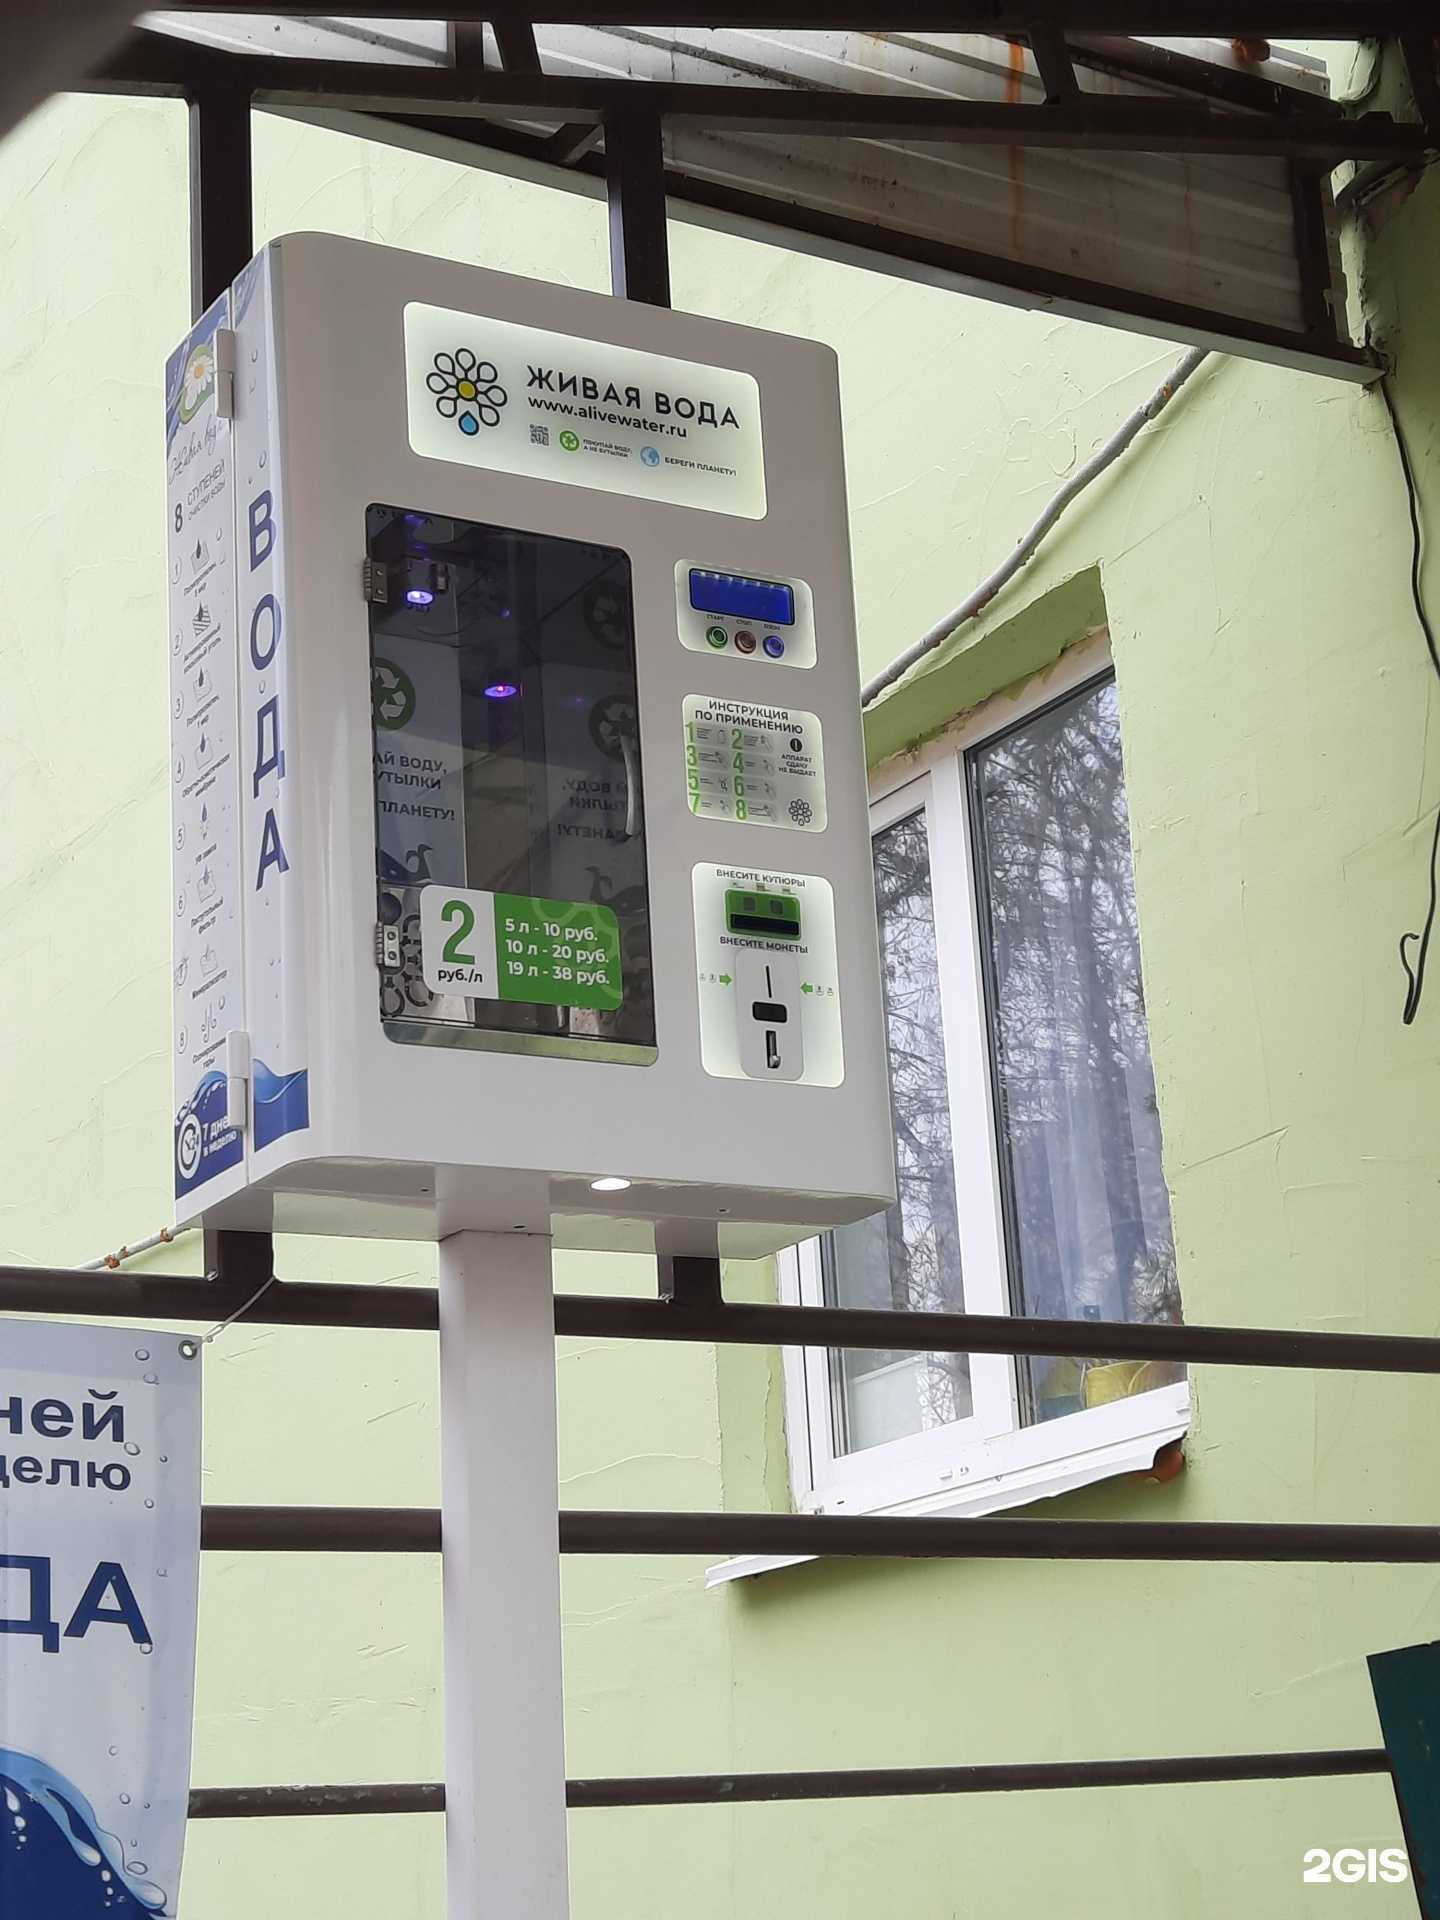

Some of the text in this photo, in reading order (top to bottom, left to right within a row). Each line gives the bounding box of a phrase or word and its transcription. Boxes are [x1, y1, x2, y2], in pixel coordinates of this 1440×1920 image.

[527, 365, 740, 430] ЖИВАЯ ВОДА
[528, 396, 687, 438] www.alivewater.ru
[664, 457, 737, 477] БЕРЕГИ ПЛАНЕТУ!
[175, 502, 184, 533] 8
[249, 490, 290, 891] ВОДА
[709, 700, 789, 721] ИНСТРУКЦИЯ
[685, 721, 694, 743] 1
[695, 710, 713, 721] ПО
[716, 712, 803, 735] ПРИМЕНЕНИЮ
[732, 728, 743, 750] 2
[400, 755, 447, 776] ВОДУ,
[687, 744, 697, 766] 3
[733, 752, 744, 774] 4
[781, 753, 813, 764] АППАРАТ
[688, 768, 699, 790] 5
[734, 775, 744, 797] 6
[689, 792, 700, 813] 7
[736, 799, 747, 820] 8
[716, 869, 806, 888] ВНЕСИТЕ КУПЮРЫ
[441, 899, 475, 965] 2
[505, 918, 515, 933] 5
[518, 923, 530, 934] л
[543, 922, 561, 937] 10
[564, 927, 599, 942] руб.
[505, 940, 524, 954] 10
[527, 944, 538, 956] л
[552, 945, 572, 960] 20
[576, 949, 610, 965] руб.
[720, 936, 809, 954] ВНЕСИТЕ МОНЕТЫ
[438, 968, 483, 984] руб./л
[506, 961, 524, 976] 19
[527, 965, 539, 977] л
[552, 966, 573, 981] 38
[576, 970, 611, 986] руб.
[203, 1123, 209, 1141] 7
